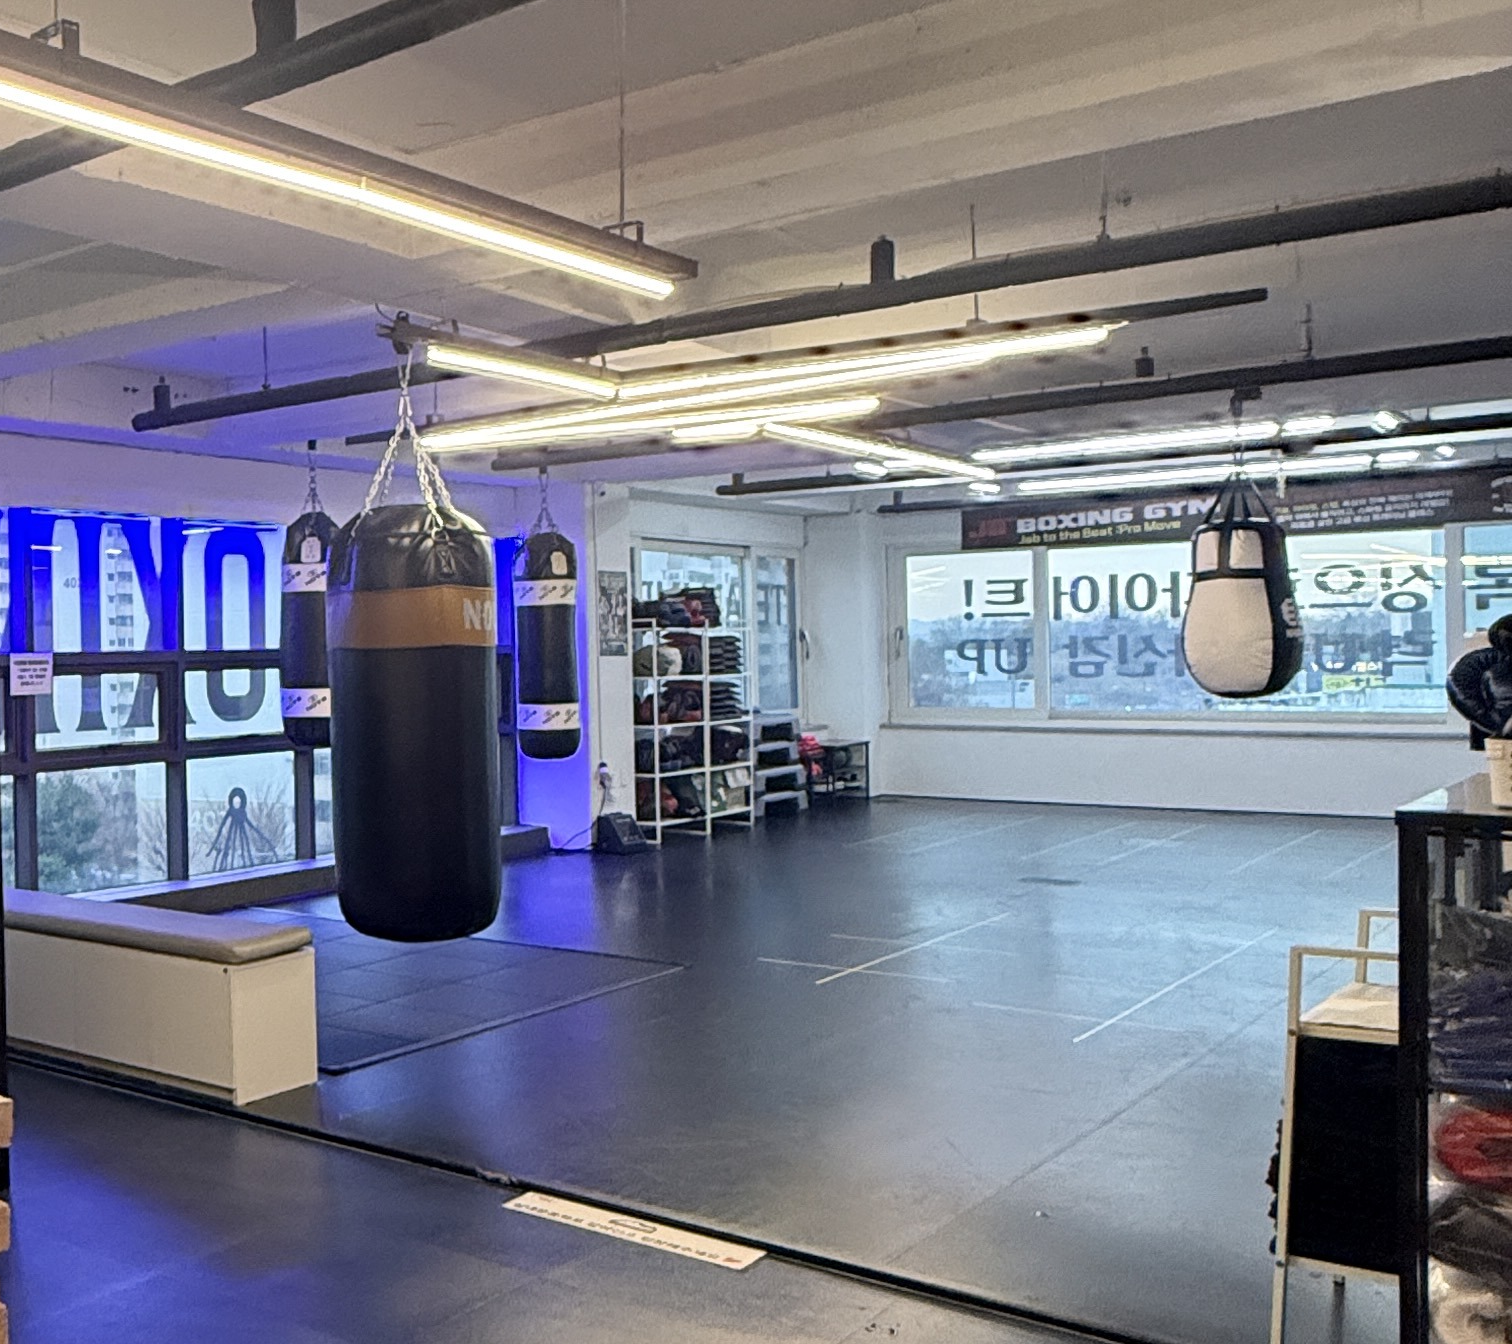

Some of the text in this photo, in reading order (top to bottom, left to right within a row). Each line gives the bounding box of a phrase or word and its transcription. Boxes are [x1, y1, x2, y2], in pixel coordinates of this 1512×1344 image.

[1016, 506, 1134, 534] BOXING
[1143, 495, 1222, 520] GYM
[1043, 532, 1058, 543] to
[1058, 529, 1081, 541] the
